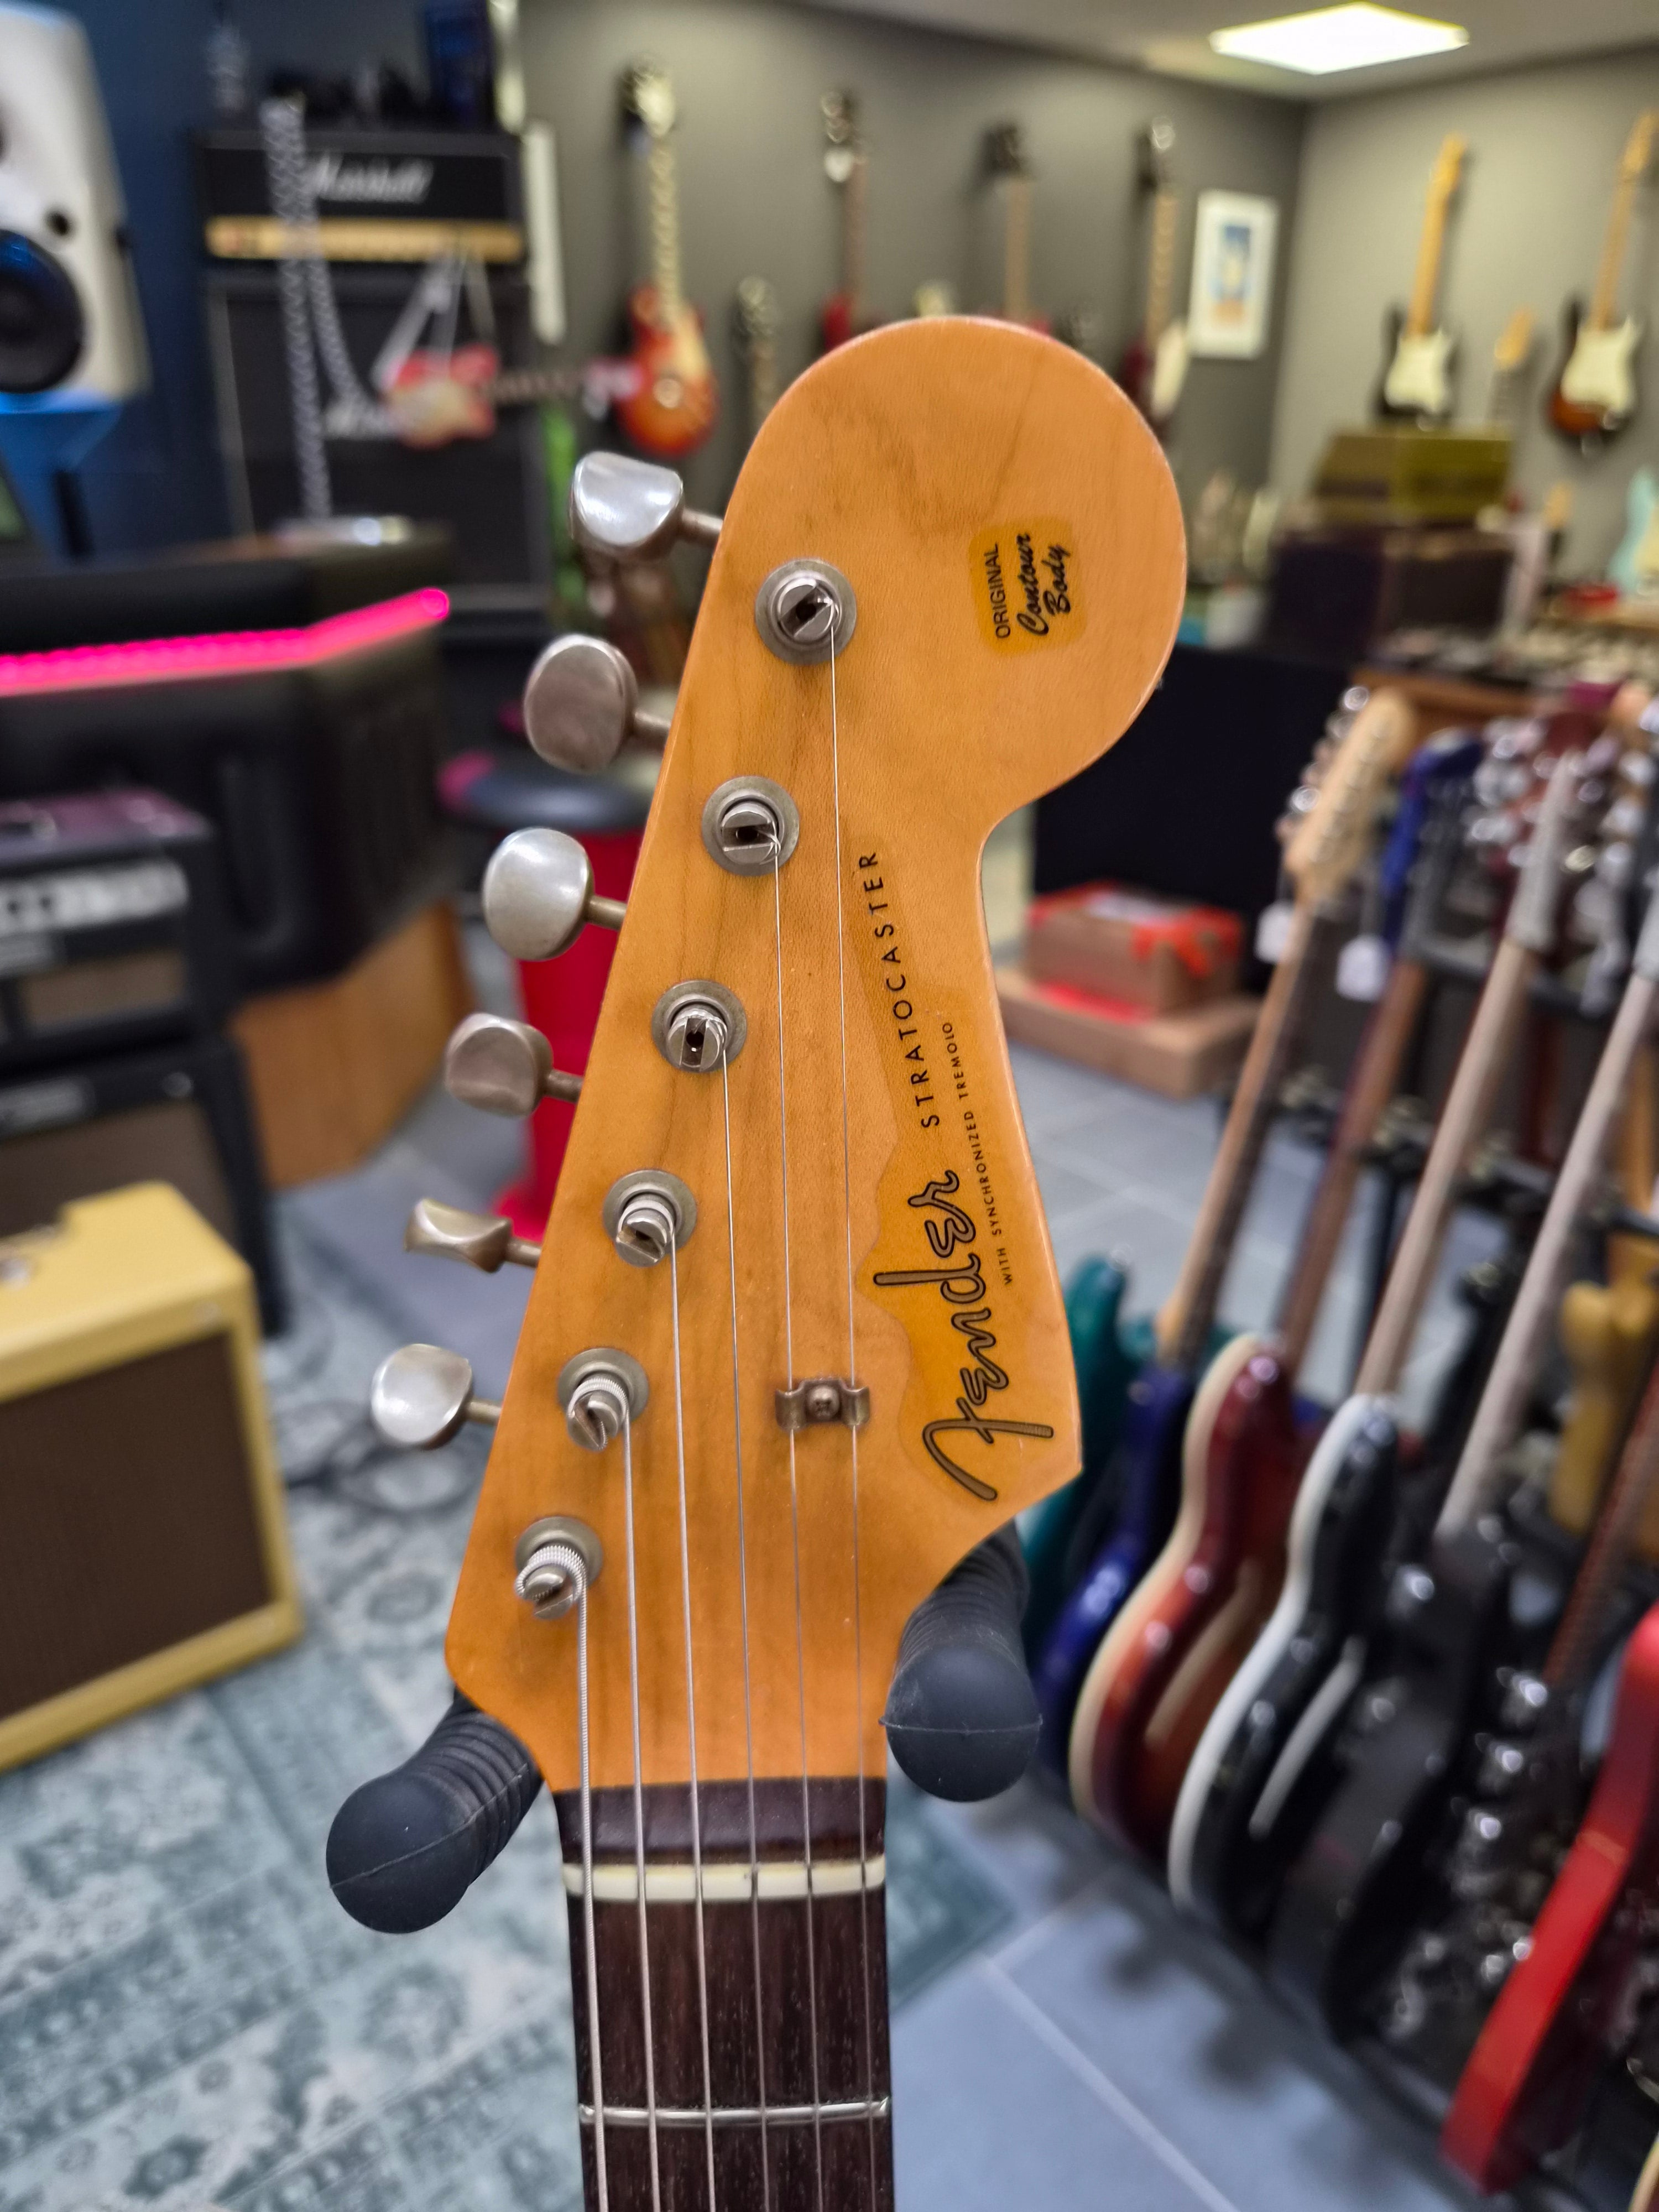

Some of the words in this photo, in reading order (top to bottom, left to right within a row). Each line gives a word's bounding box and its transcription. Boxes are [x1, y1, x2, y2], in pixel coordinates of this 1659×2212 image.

[984, 543, 1011, 639] ORIGINAL
[1016, 533, 1050, 636] Contour
[1041, 544, 1071, 616] Body
[858, 852, 940, 1128] STRATOCASTER
[942, 1022, 969, 1100] TREMOLO
[964, 1110, 1002, 1236] SYNCHRONIZED
[997, 1248, 1013, 1285] WITH
[873, 1169, 1054, 1501] Fender
